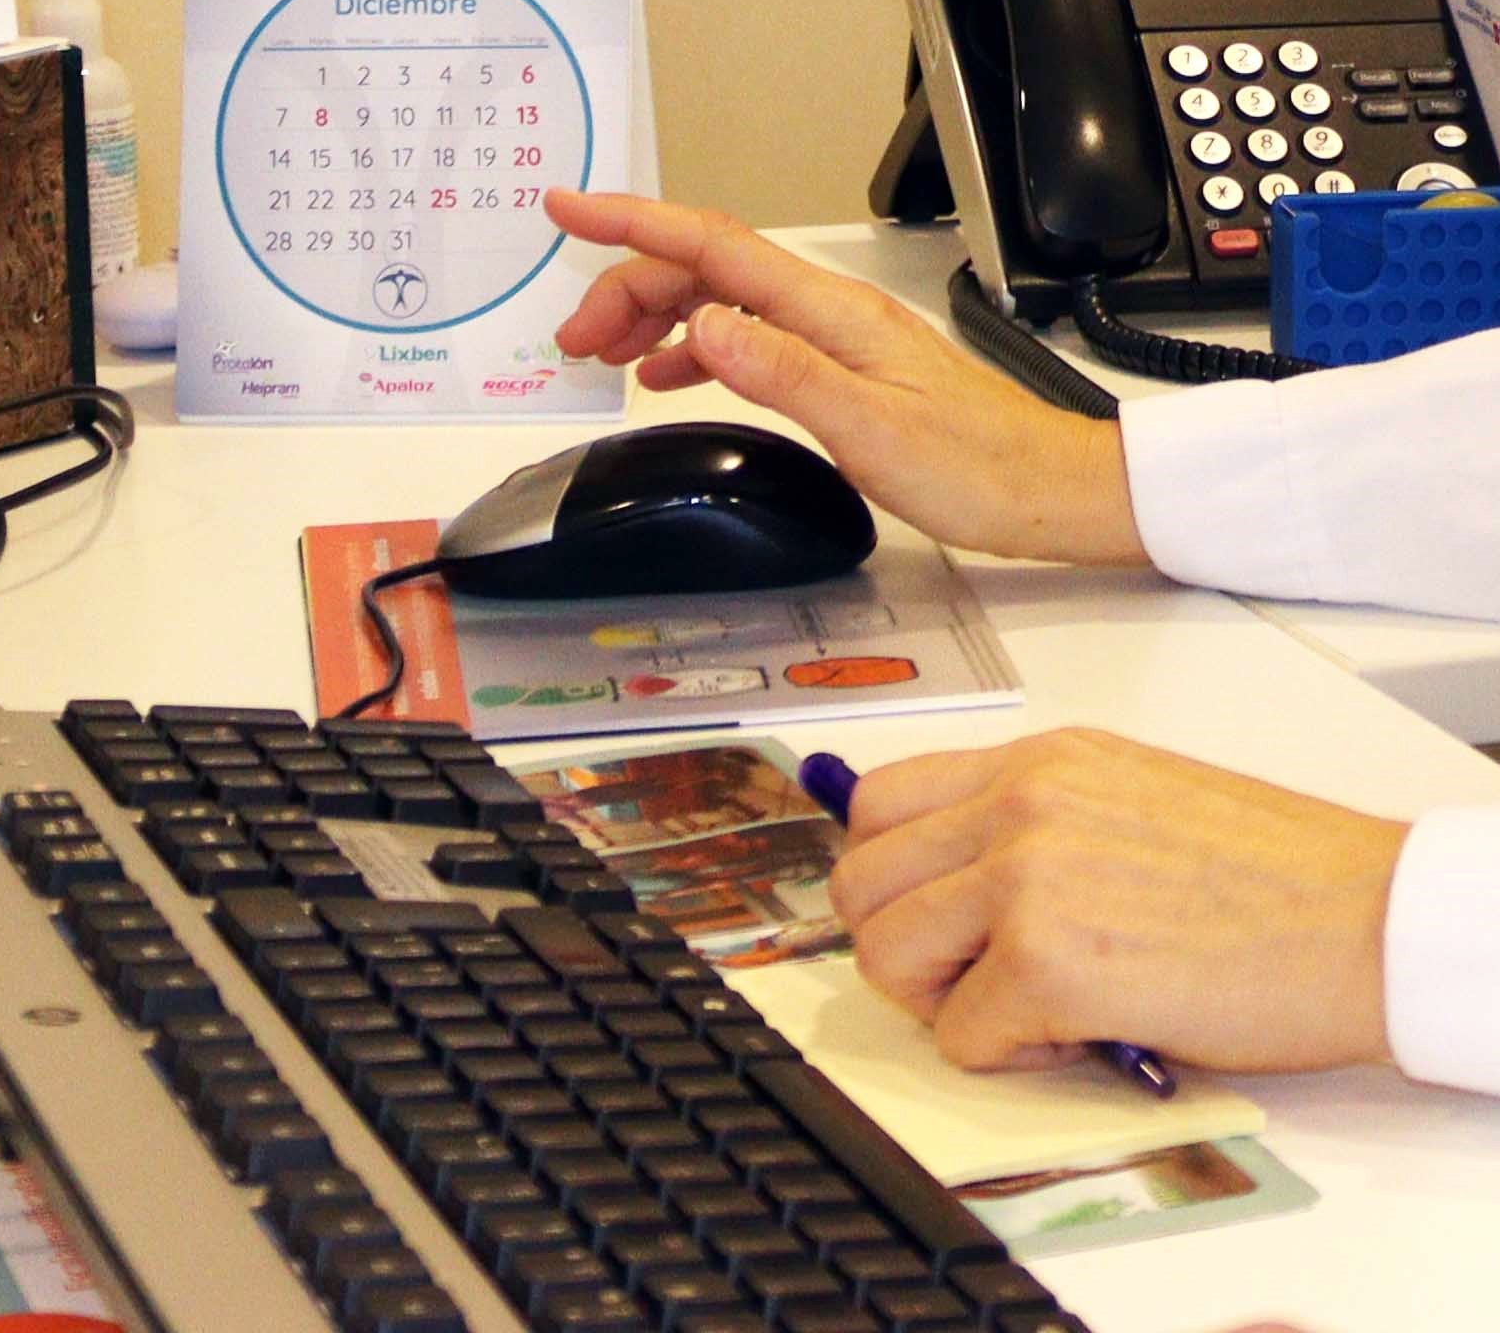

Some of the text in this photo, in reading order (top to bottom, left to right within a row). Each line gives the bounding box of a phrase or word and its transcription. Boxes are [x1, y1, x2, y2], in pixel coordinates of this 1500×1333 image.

[1237, 49, 1248, 62] 2
[1292, 46, 1303, 61] 3
[318, 64, 535, 86] 1 2 3 4 5 6
[1192, 88, 1315, 107] 4 5 6
[277, 105, 539, 128] 7 8 9 10 11 12 13
[1204, 131, 1328, 151] 7 8 9
[269, 147, 541, 169] 14 15 16 17 18 19 20
[269, 187, 541, 210] 21 22 23 24 25 26 27
[266, 230, 412, 251] 28 29 30 31
[379, 345, 449, 362] Lixben
[372, 377, 435, 396] Apaloz
